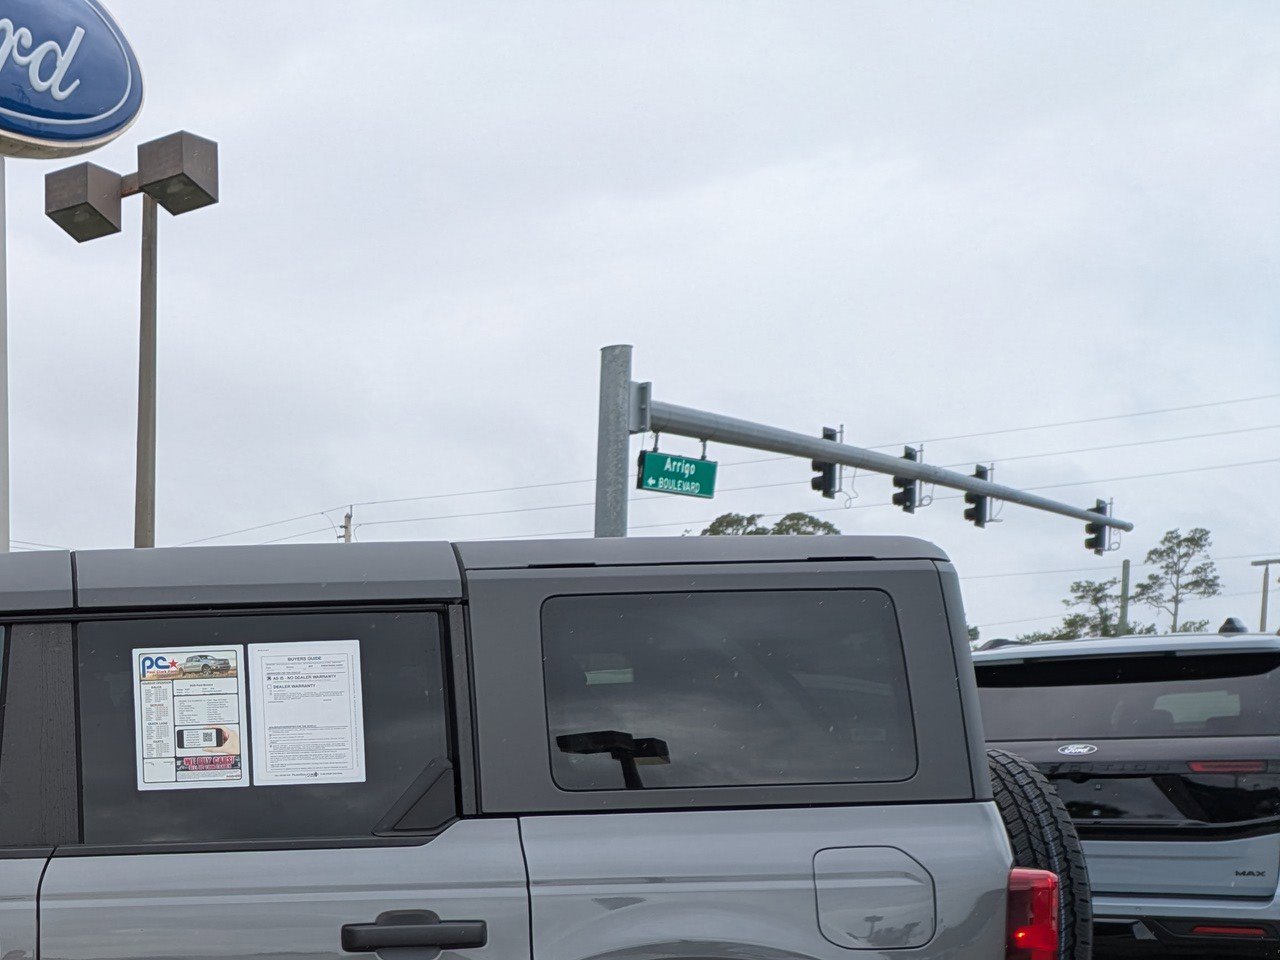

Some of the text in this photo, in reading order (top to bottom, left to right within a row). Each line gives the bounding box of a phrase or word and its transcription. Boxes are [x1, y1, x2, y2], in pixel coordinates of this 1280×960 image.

[663, 457, 696, 478] Arrigo
[658, 477, 700, 494] BOULEVARD
[184, 755, 235, 765] WE BUY CARS!
[1234, 869, 1266, 877] MAX
